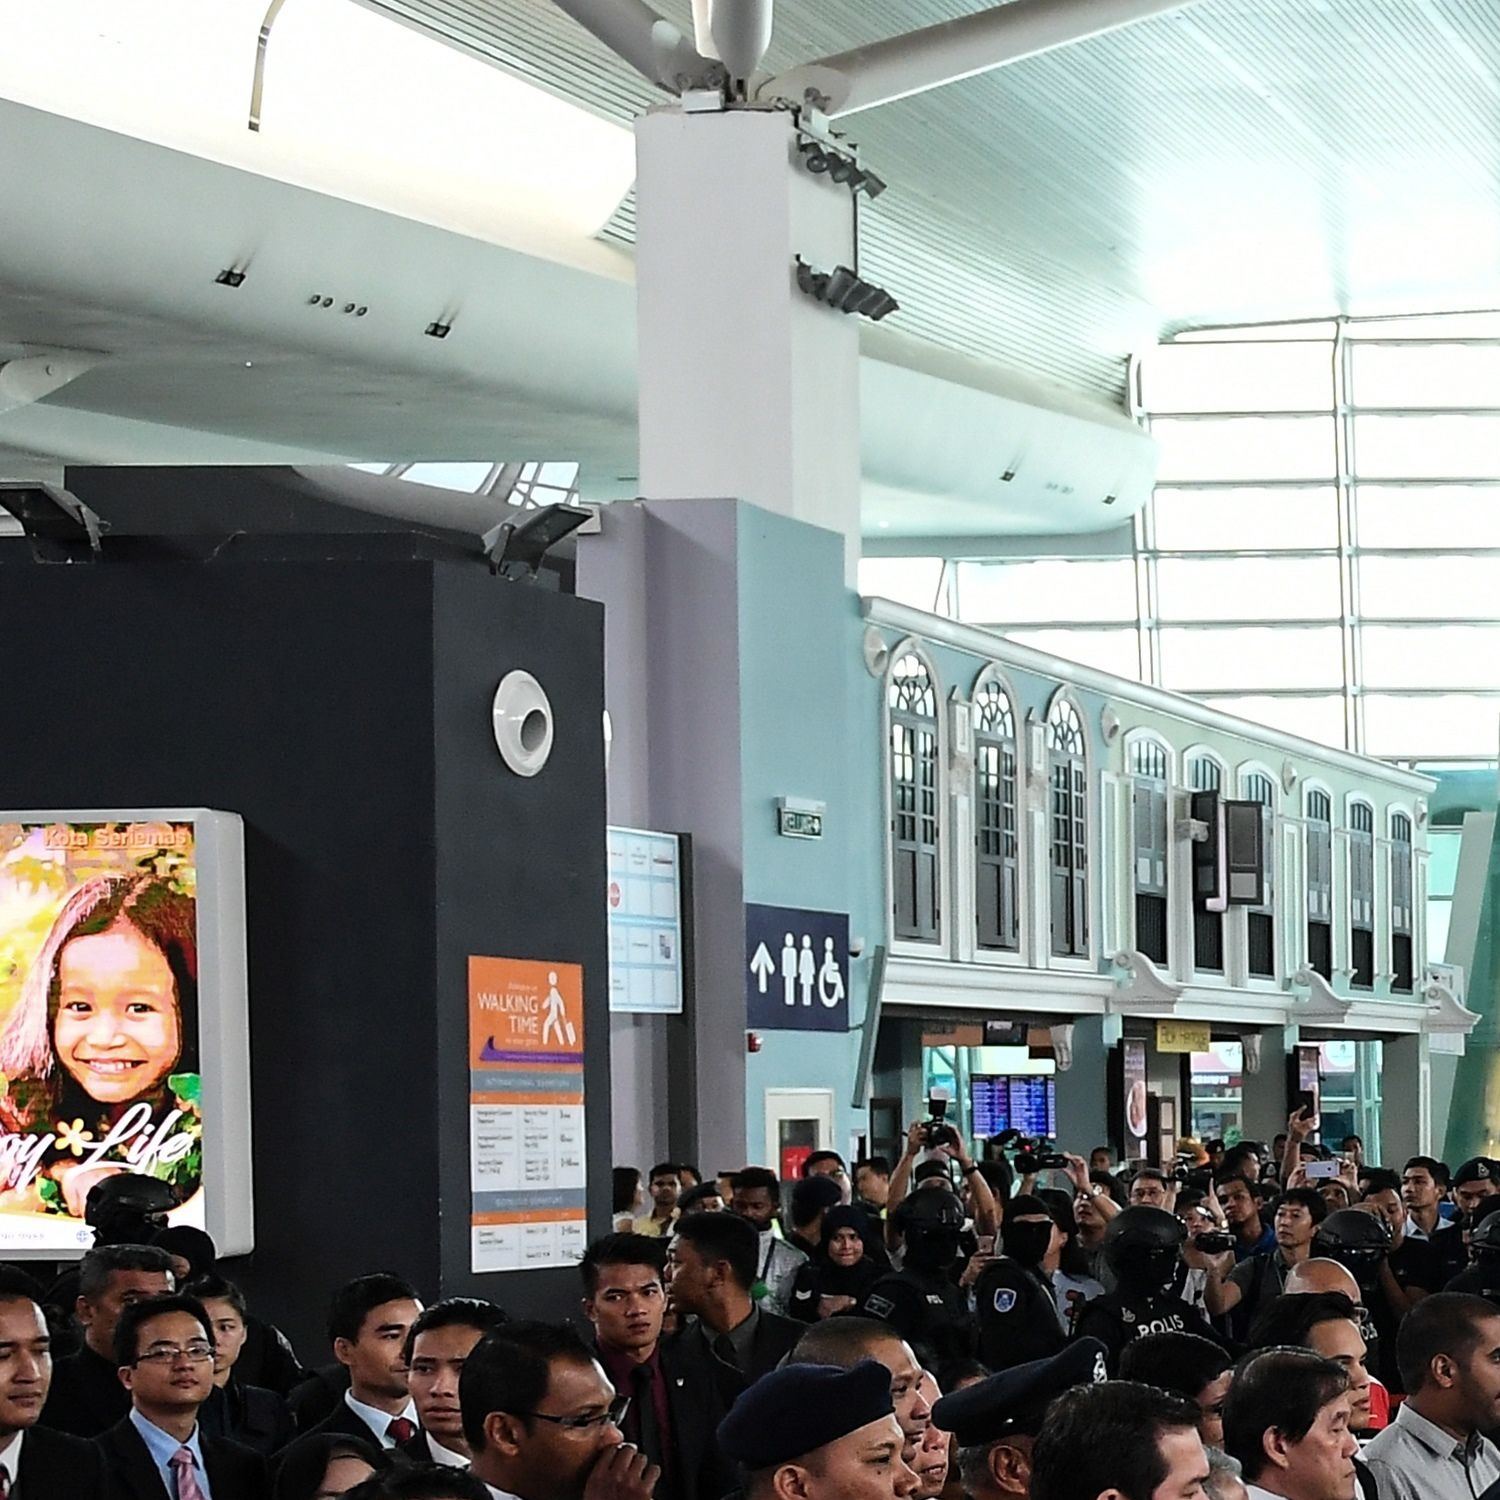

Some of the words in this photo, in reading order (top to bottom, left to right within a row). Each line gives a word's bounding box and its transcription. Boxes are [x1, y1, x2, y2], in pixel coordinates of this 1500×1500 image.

[45, 828, 89, 846] Kota
[477, 991, 539, 1014] WALKING
[508, 1015, 539, 1035] TIME
[62, 1102, 196, 1176] Life
[1136, 1313, 1185, 1339] POLIS
